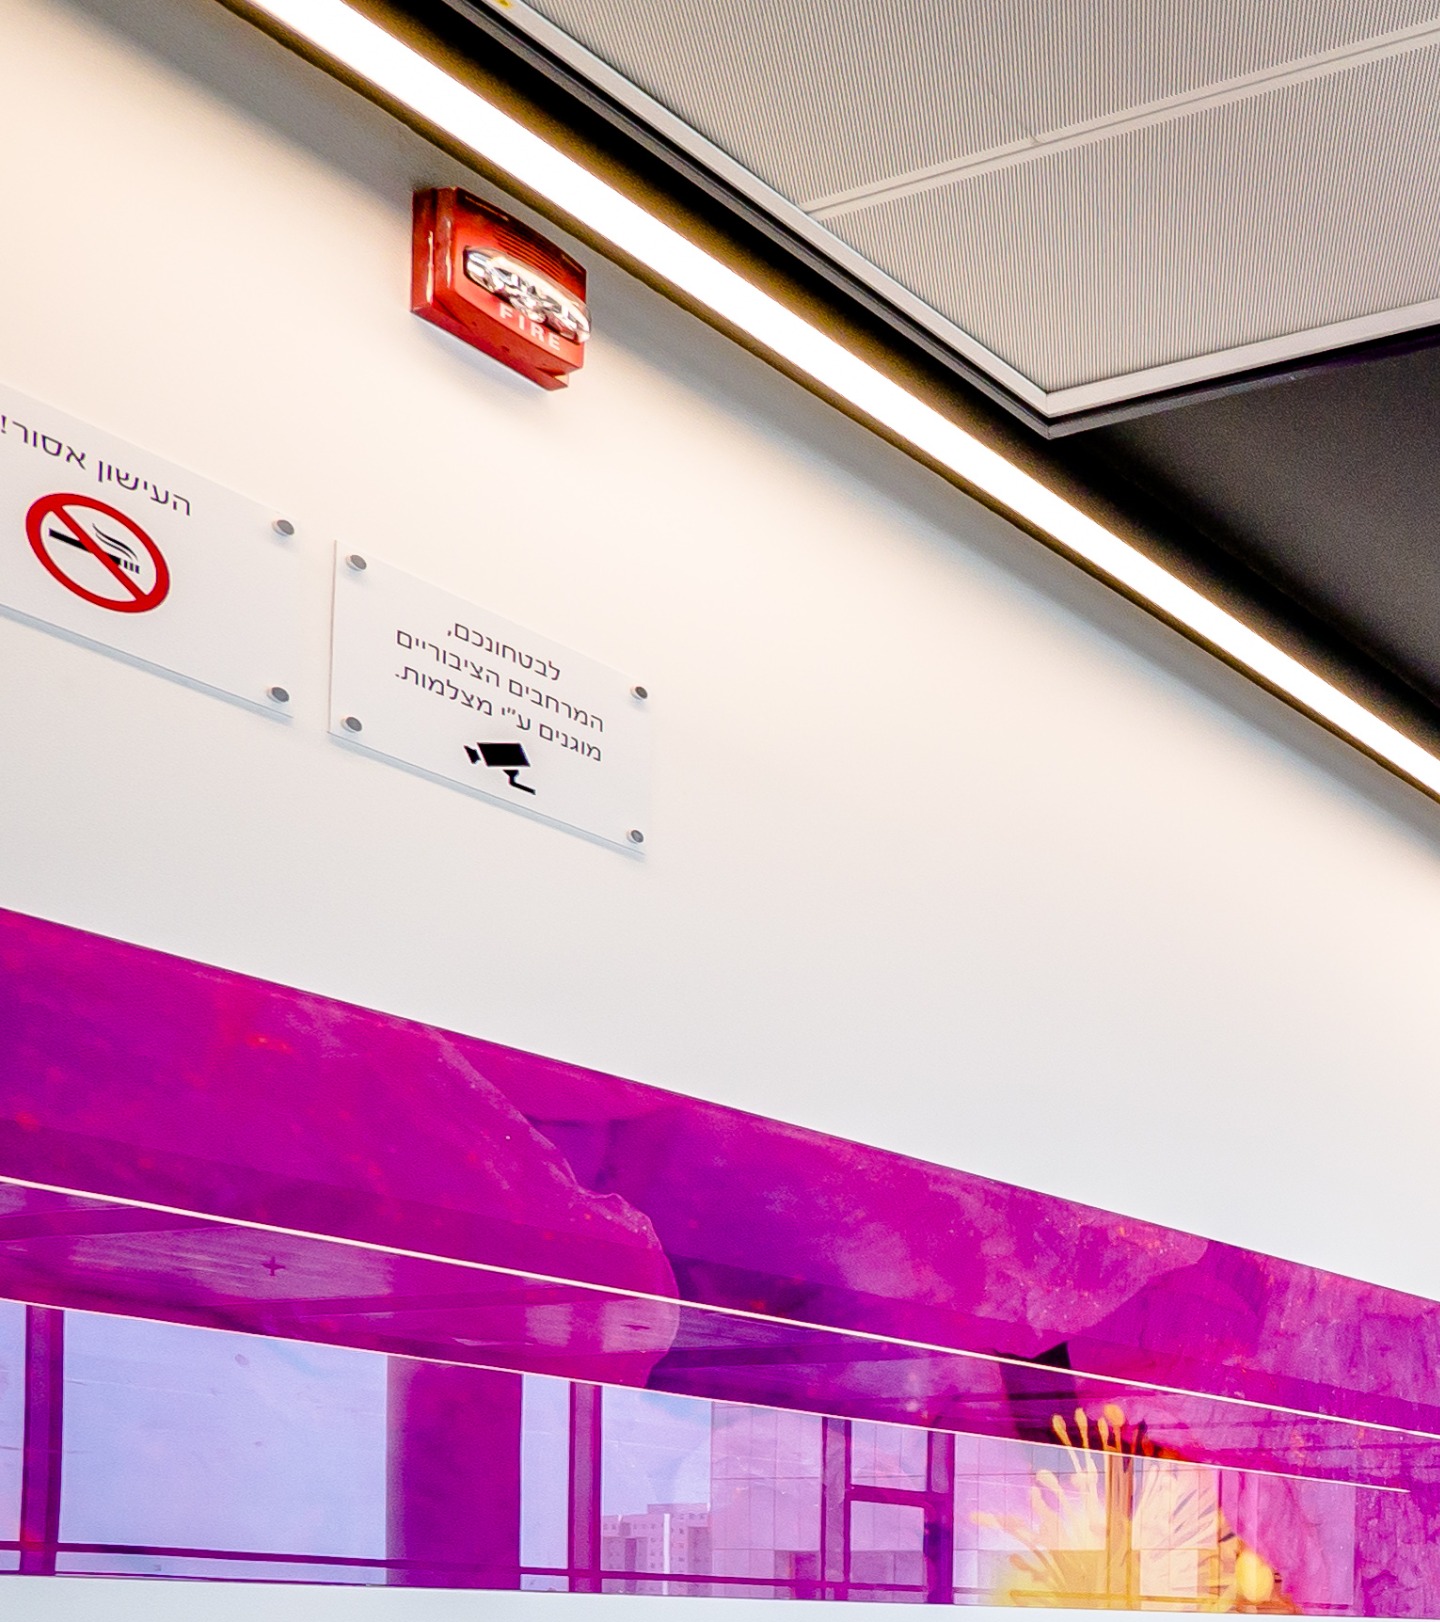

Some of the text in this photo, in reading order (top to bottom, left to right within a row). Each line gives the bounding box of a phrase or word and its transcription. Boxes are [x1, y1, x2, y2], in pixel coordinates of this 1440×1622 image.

[499, 302, 561, 351] FIRE
[0, 414, 191, 516] העישון אסור!
[447, 622, 561, 681] לבטחונכם,
[394, 665, 493, 716] מצלמות.
[396, 629, 604, 733] המרחבים הציבוריים
[539, 723, 602, 762] מוגנים
